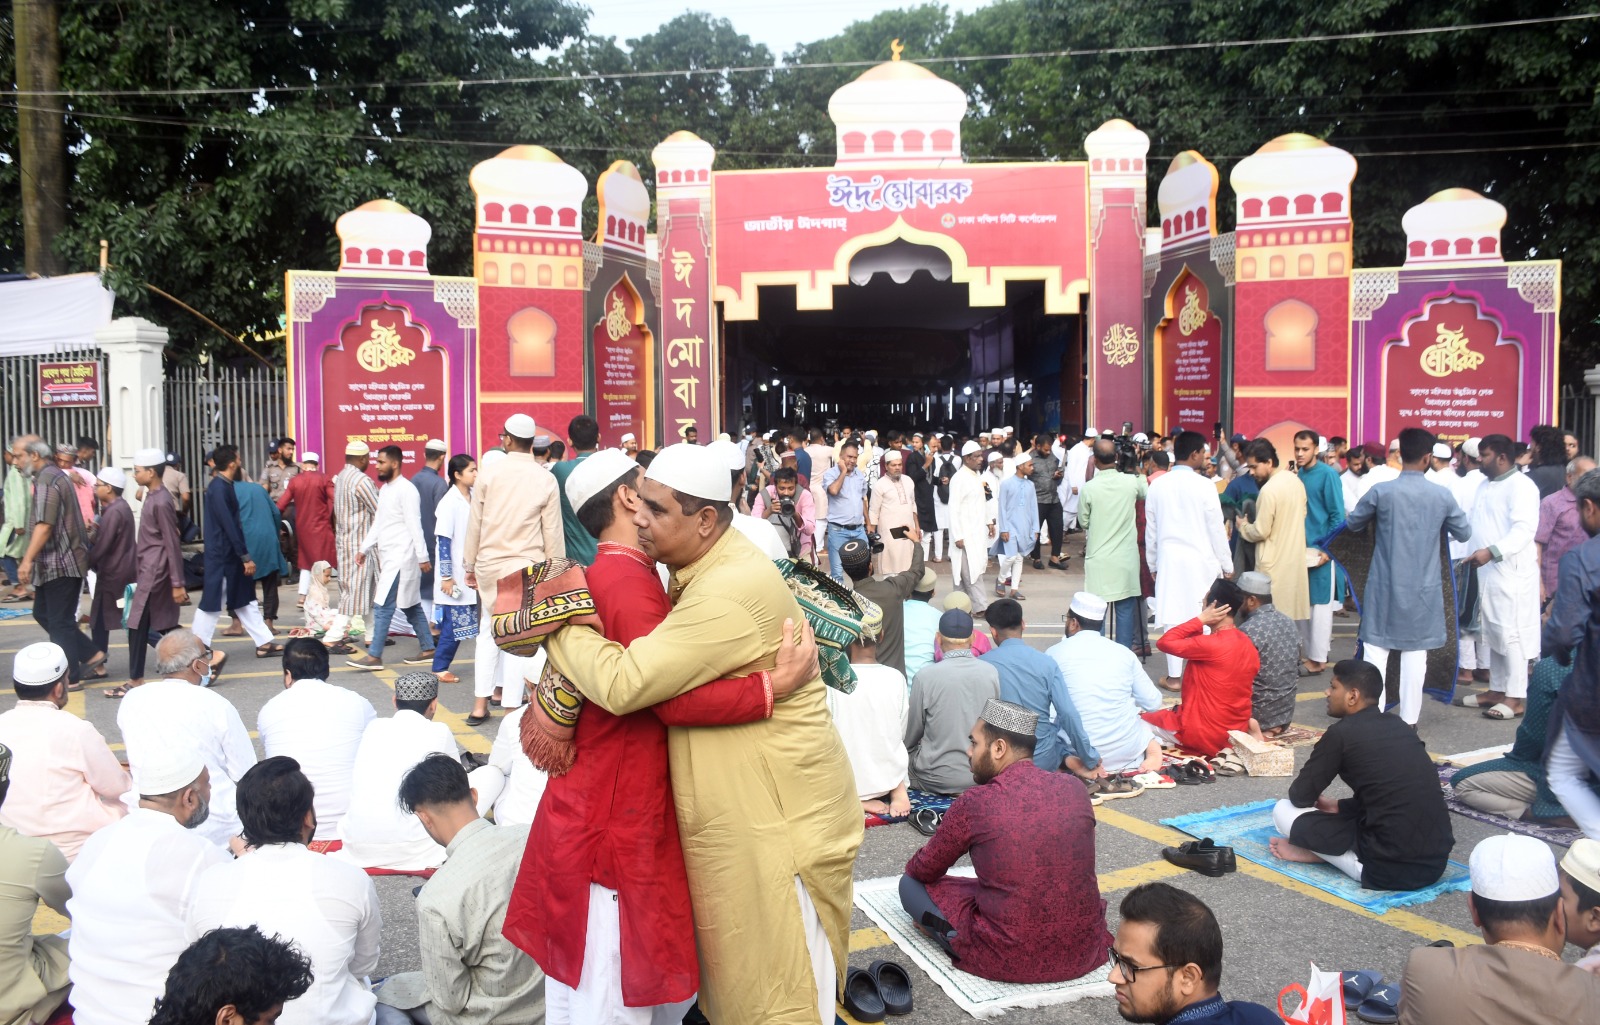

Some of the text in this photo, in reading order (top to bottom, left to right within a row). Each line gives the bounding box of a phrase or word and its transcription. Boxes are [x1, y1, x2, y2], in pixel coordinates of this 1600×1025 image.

[826, 175, 972, 211] ঈদ মোবারক
[744, 215, 794, 231] জাতীয়
